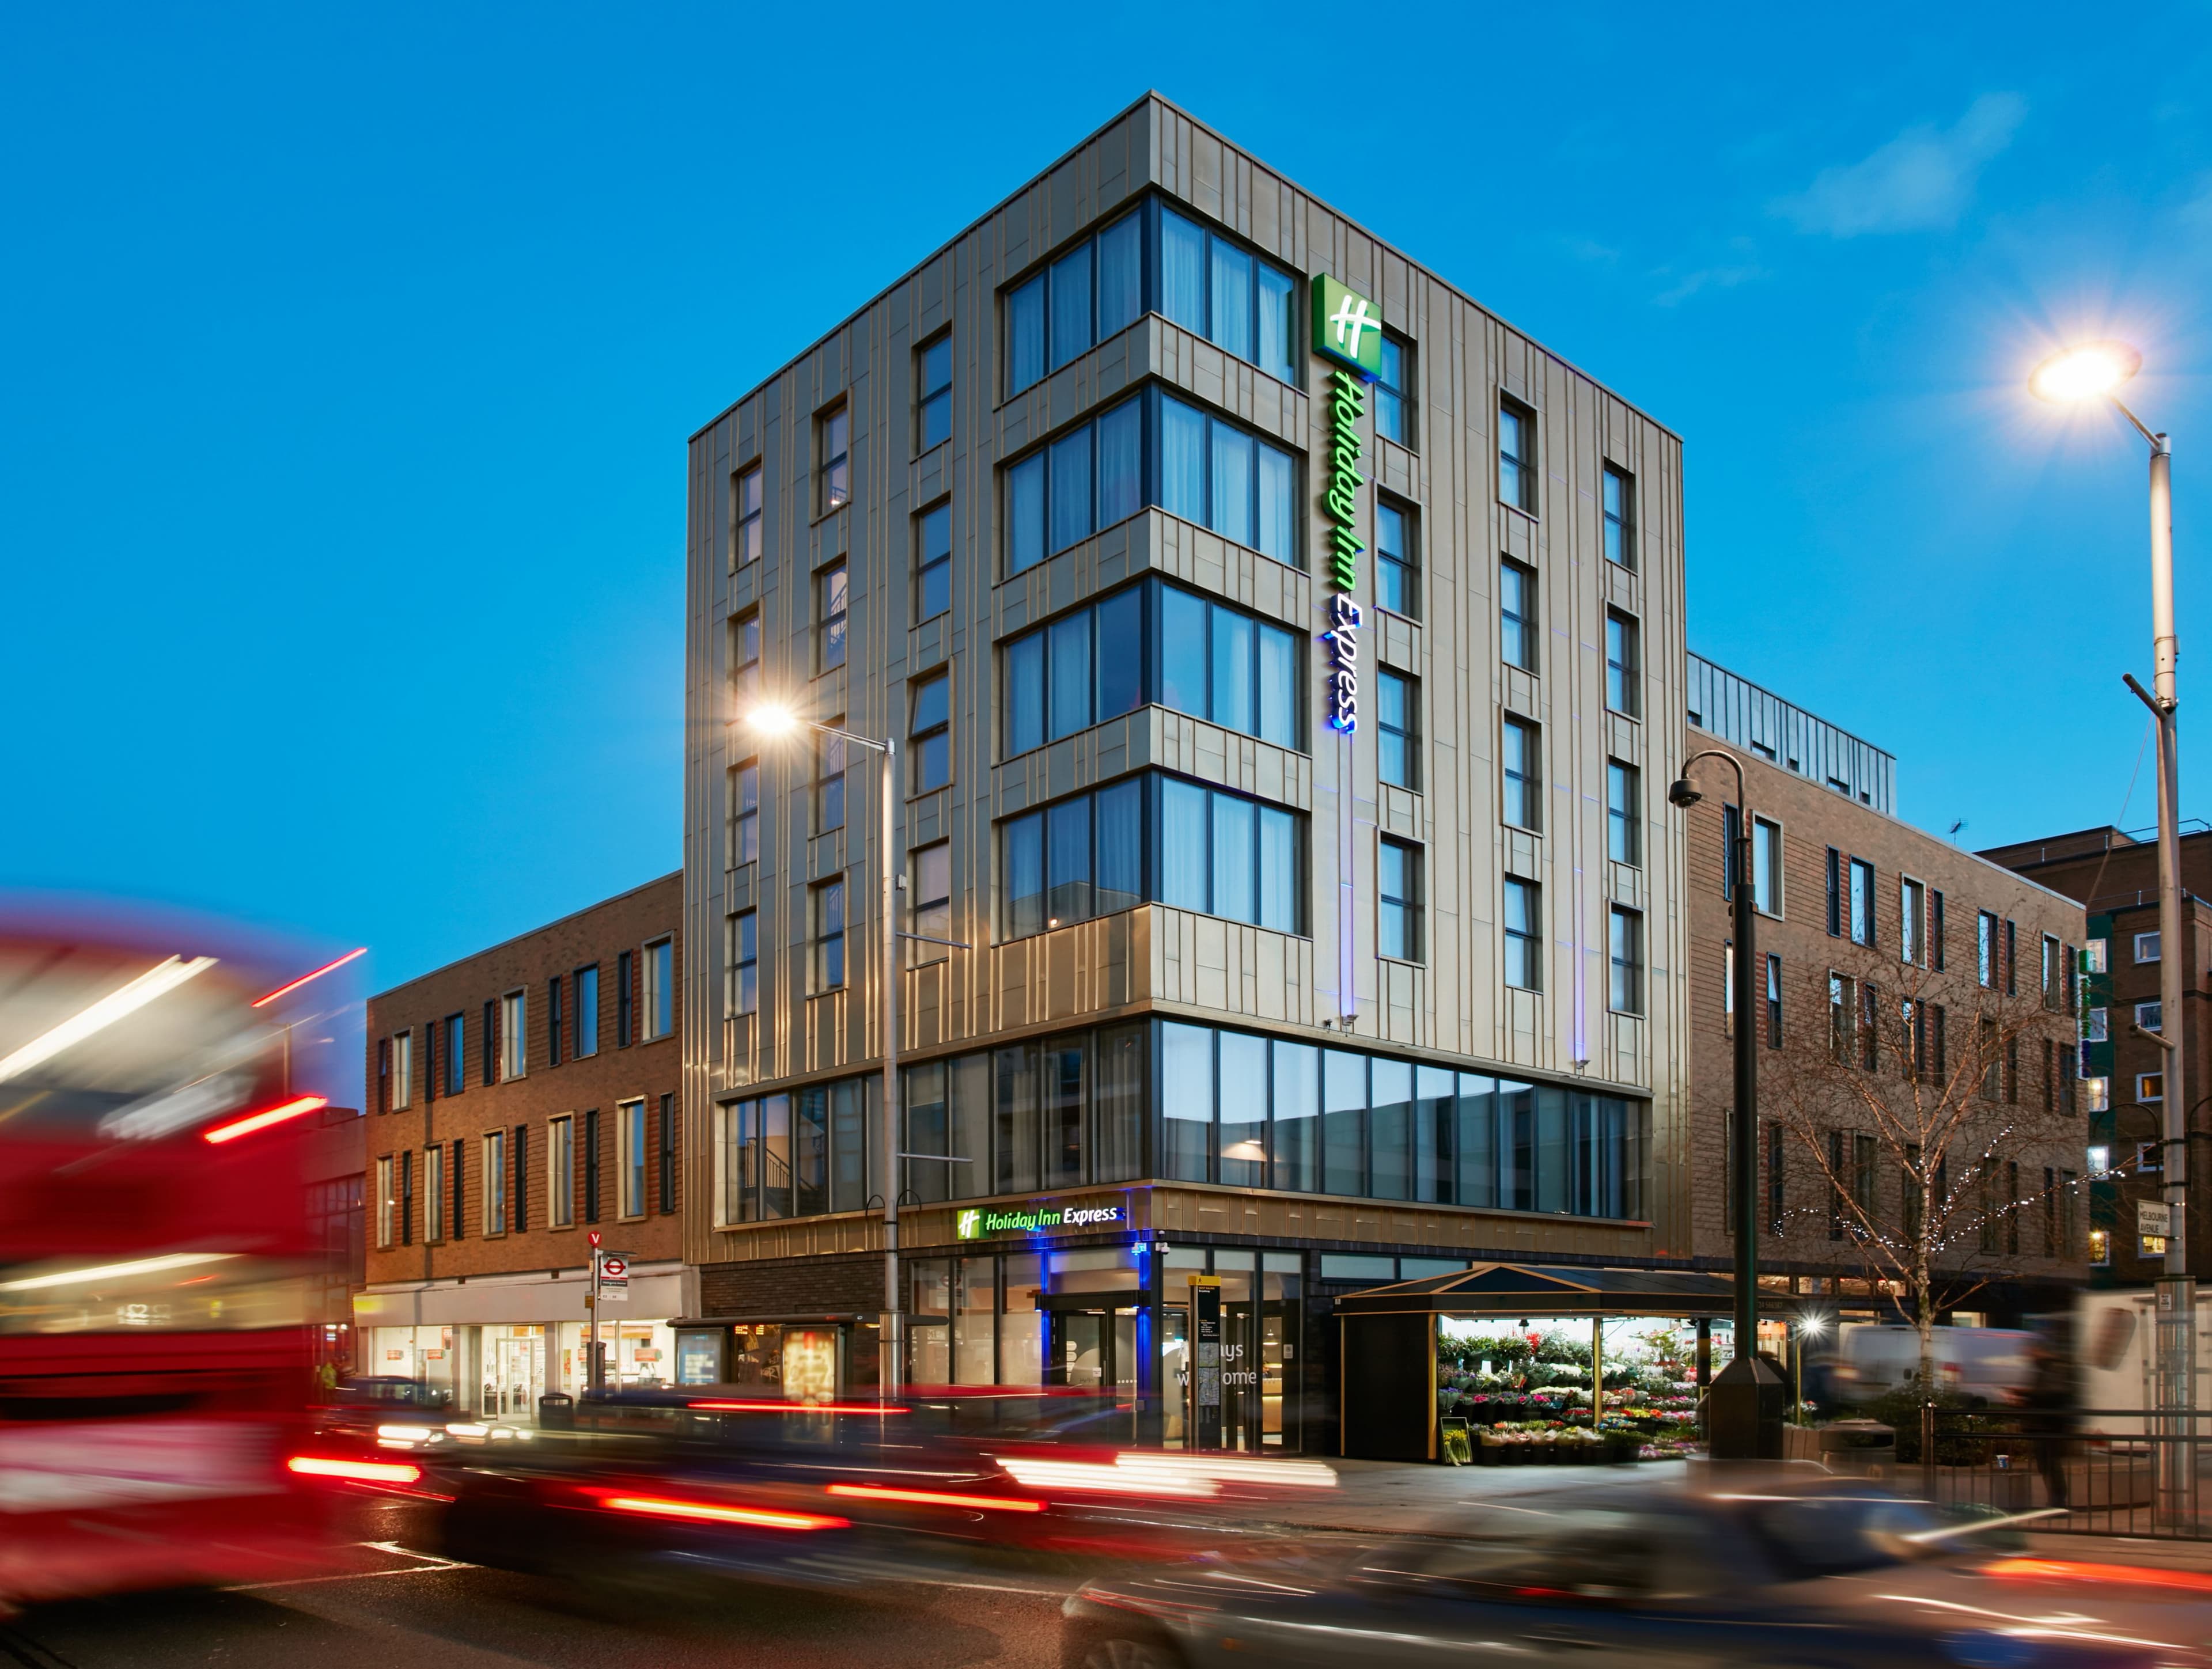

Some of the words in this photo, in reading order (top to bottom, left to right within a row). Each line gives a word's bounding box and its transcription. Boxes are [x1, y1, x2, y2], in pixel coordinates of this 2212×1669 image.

[1328, 370, 1365, 528] Holiday
[1336, 525, 1366, 592] Inn
[1330, 592, 1363, 734] Express
[985, 1211, 1036, 1231] Holiday
[1038, 1208, 1060, 1226] Inn
[1063, 1207, 1118, 1227] Express
[2139, 1211, 2168, 1223] MELBOURNE
[2140, 1223, 2160, 1234] AVENUE
[591, 1234, 600, 1244] V
